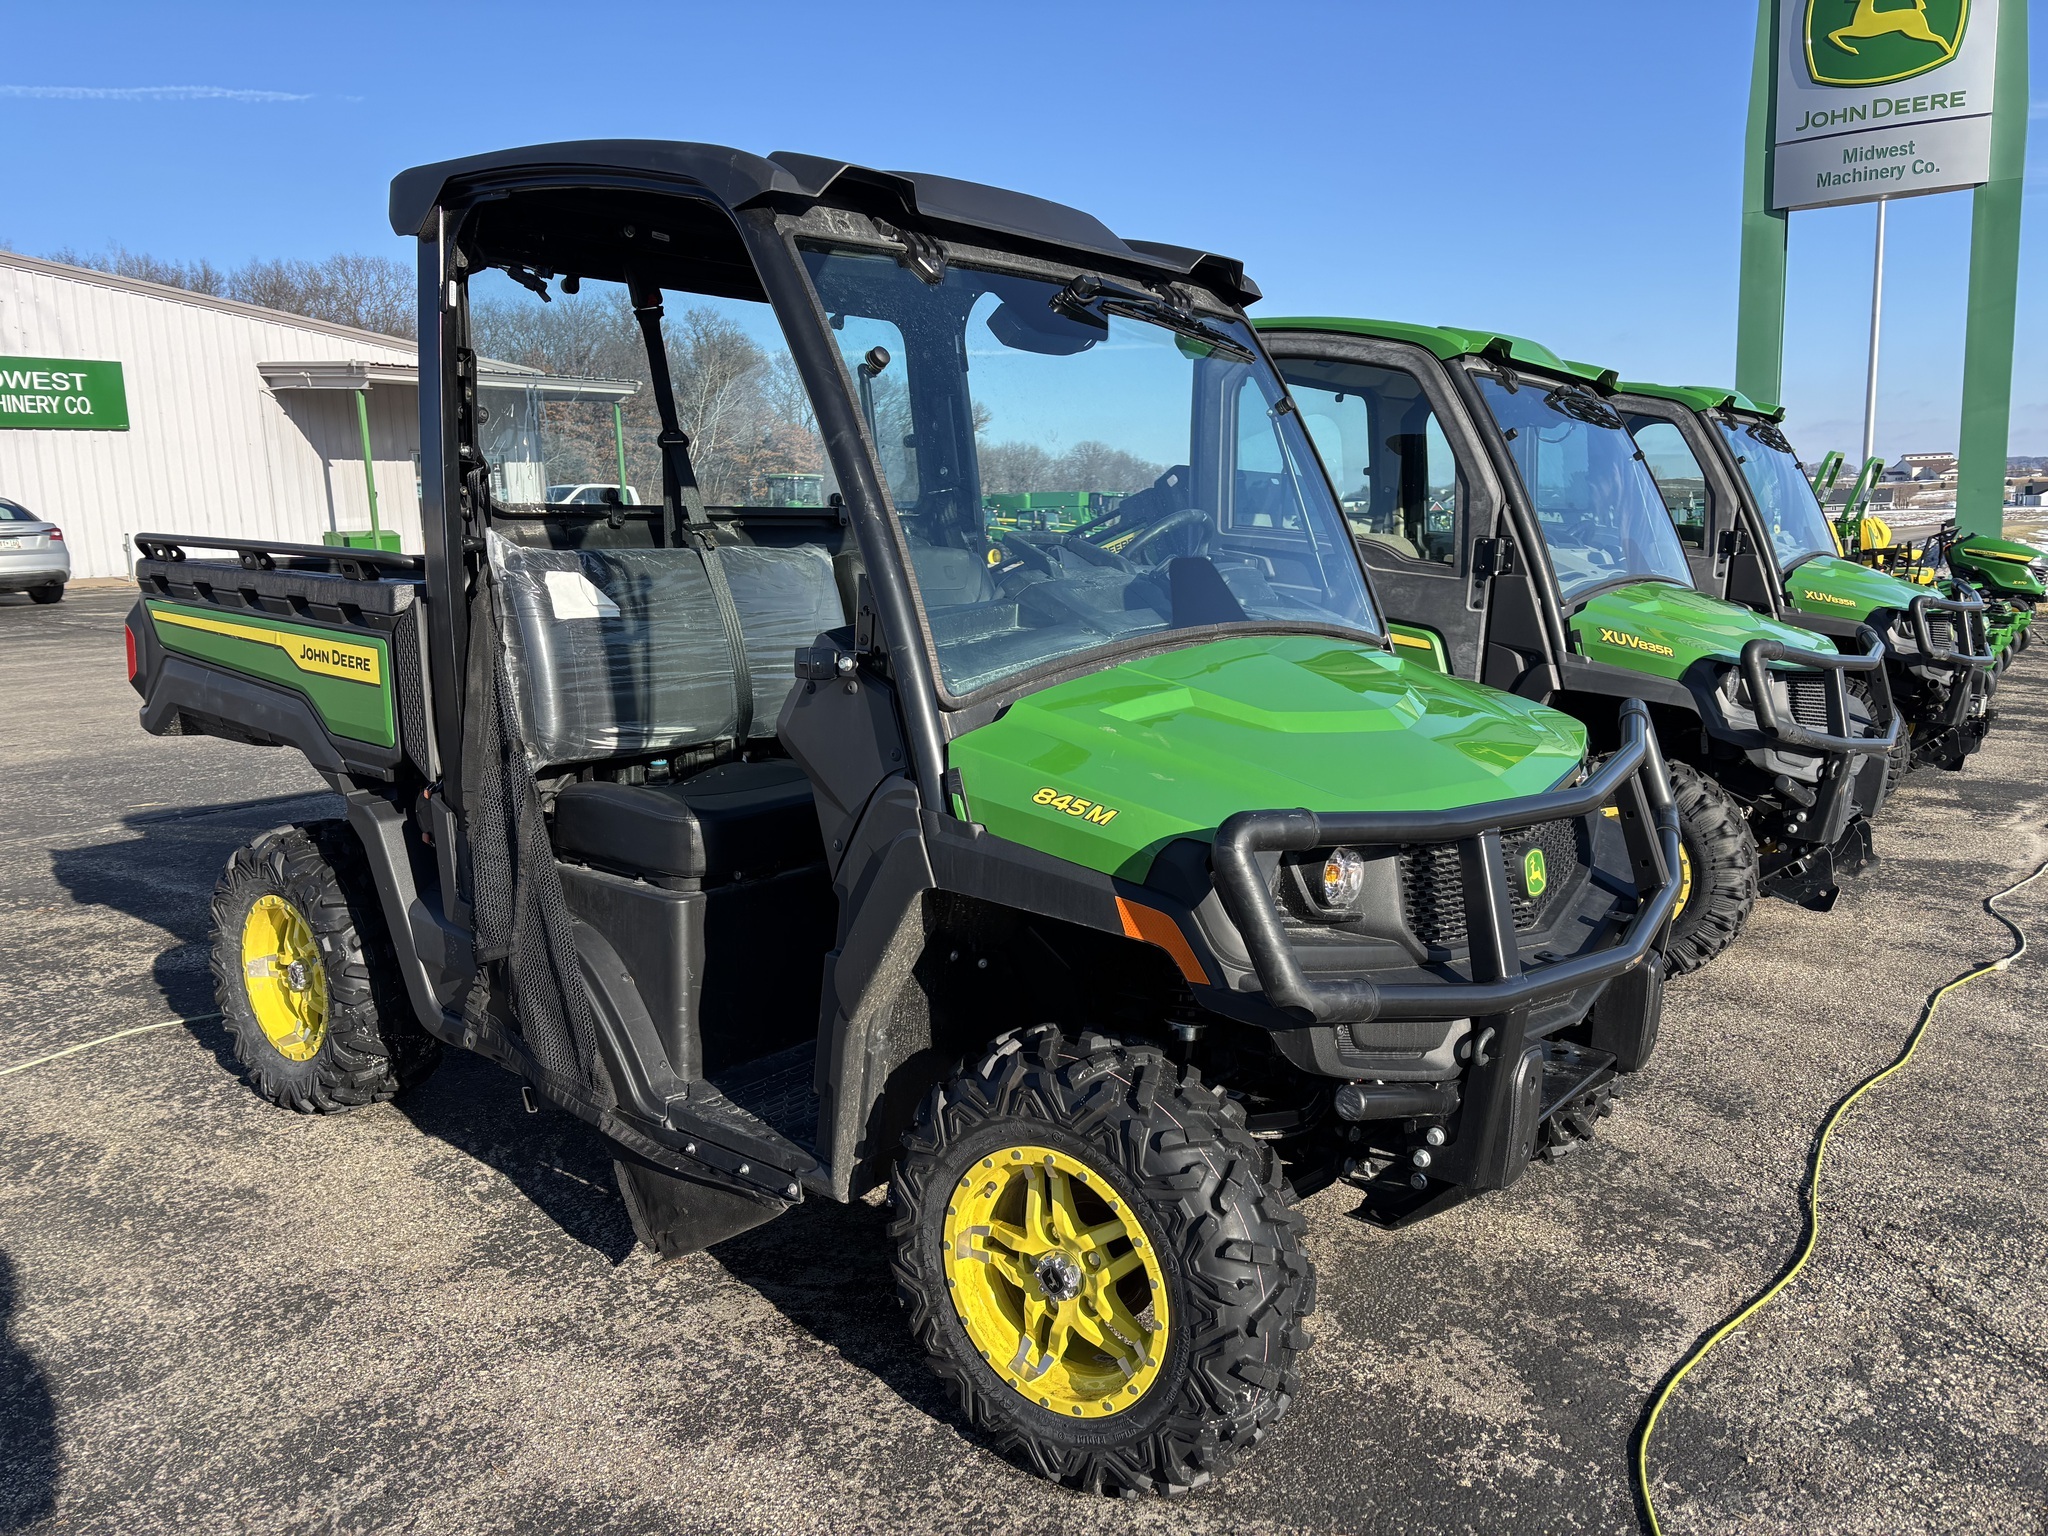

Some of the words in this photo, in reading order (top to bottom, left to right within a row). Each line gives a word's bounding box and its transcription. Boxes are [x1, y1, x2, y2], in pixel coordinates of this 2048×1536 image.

[1796, 104, 1867, 132] JOHN
[1872, 90, 1967, 119] DEERE
[1843, 140, 1916, 165] Midwest
[1816, 163, 1906, 188] Machinery
[1912, 159, 1941, 176] Co.
[64, 396, 94, 415] CO.
[1803, 589, 1857, 607] XUV835R
[1598, 627, 1676, 658] XUV835R
[300, 644, 330, 664] JOHN
[332, 649, 371, 672] DEERE
[1031, 786, 1120, 827] 845M
